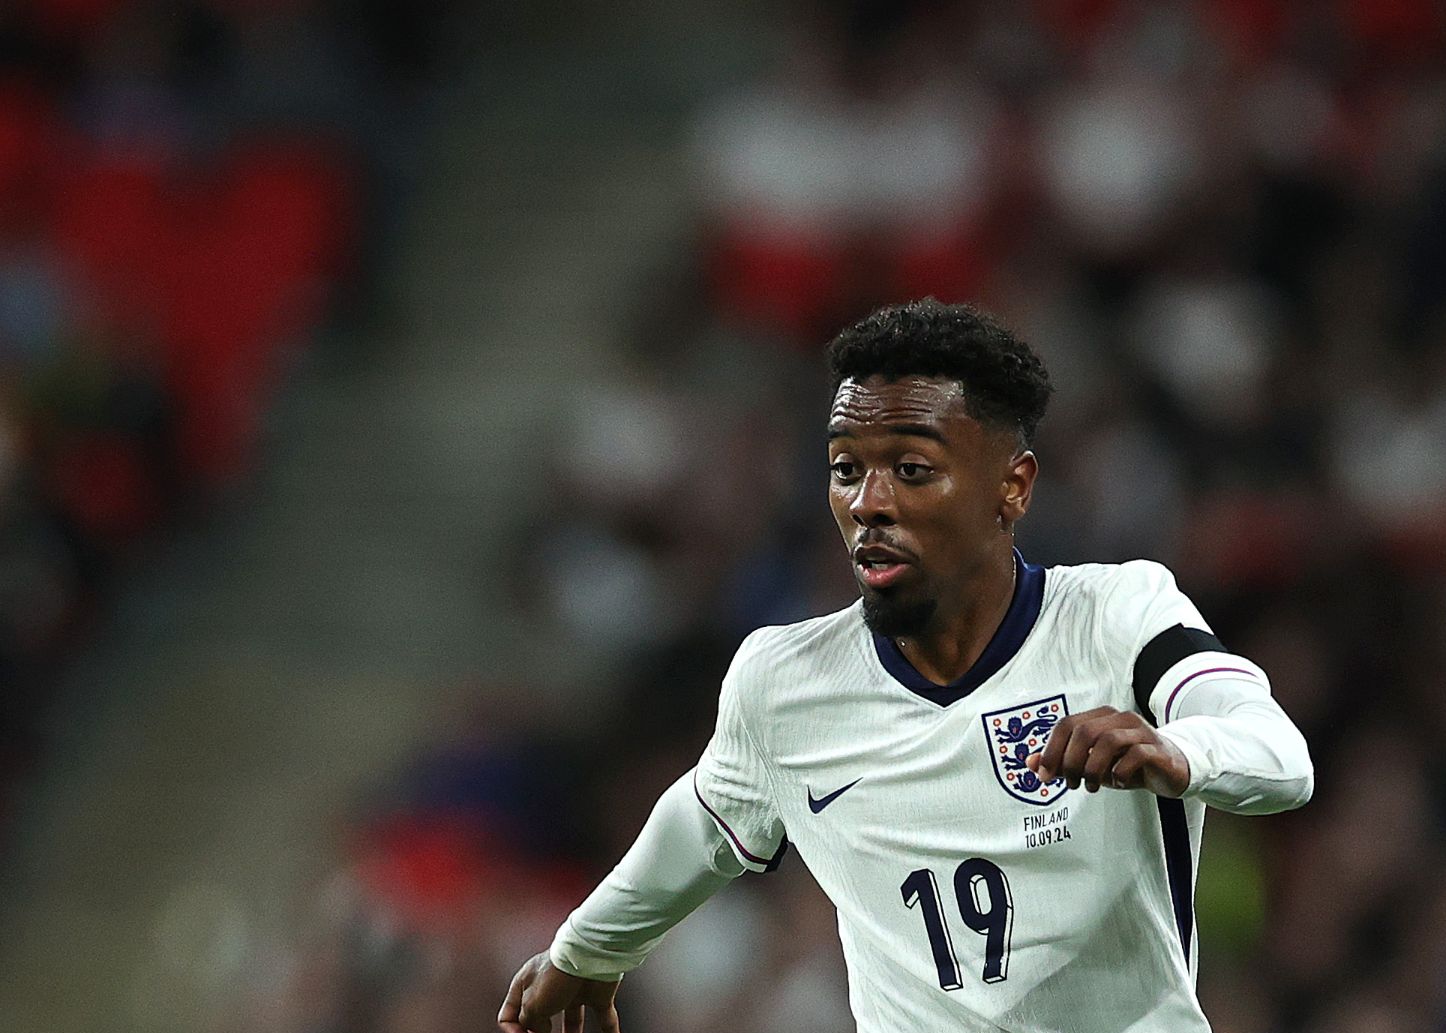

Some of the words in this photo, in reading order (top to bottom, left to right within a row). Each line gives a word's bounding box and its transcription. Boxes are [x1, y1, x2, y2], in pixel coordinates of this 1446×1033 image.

[1023, 807, 1069, 831] FINLAND
[1025, 825, 1071, 848] 10.09.24
[900, 857, 1014, 992] 19
